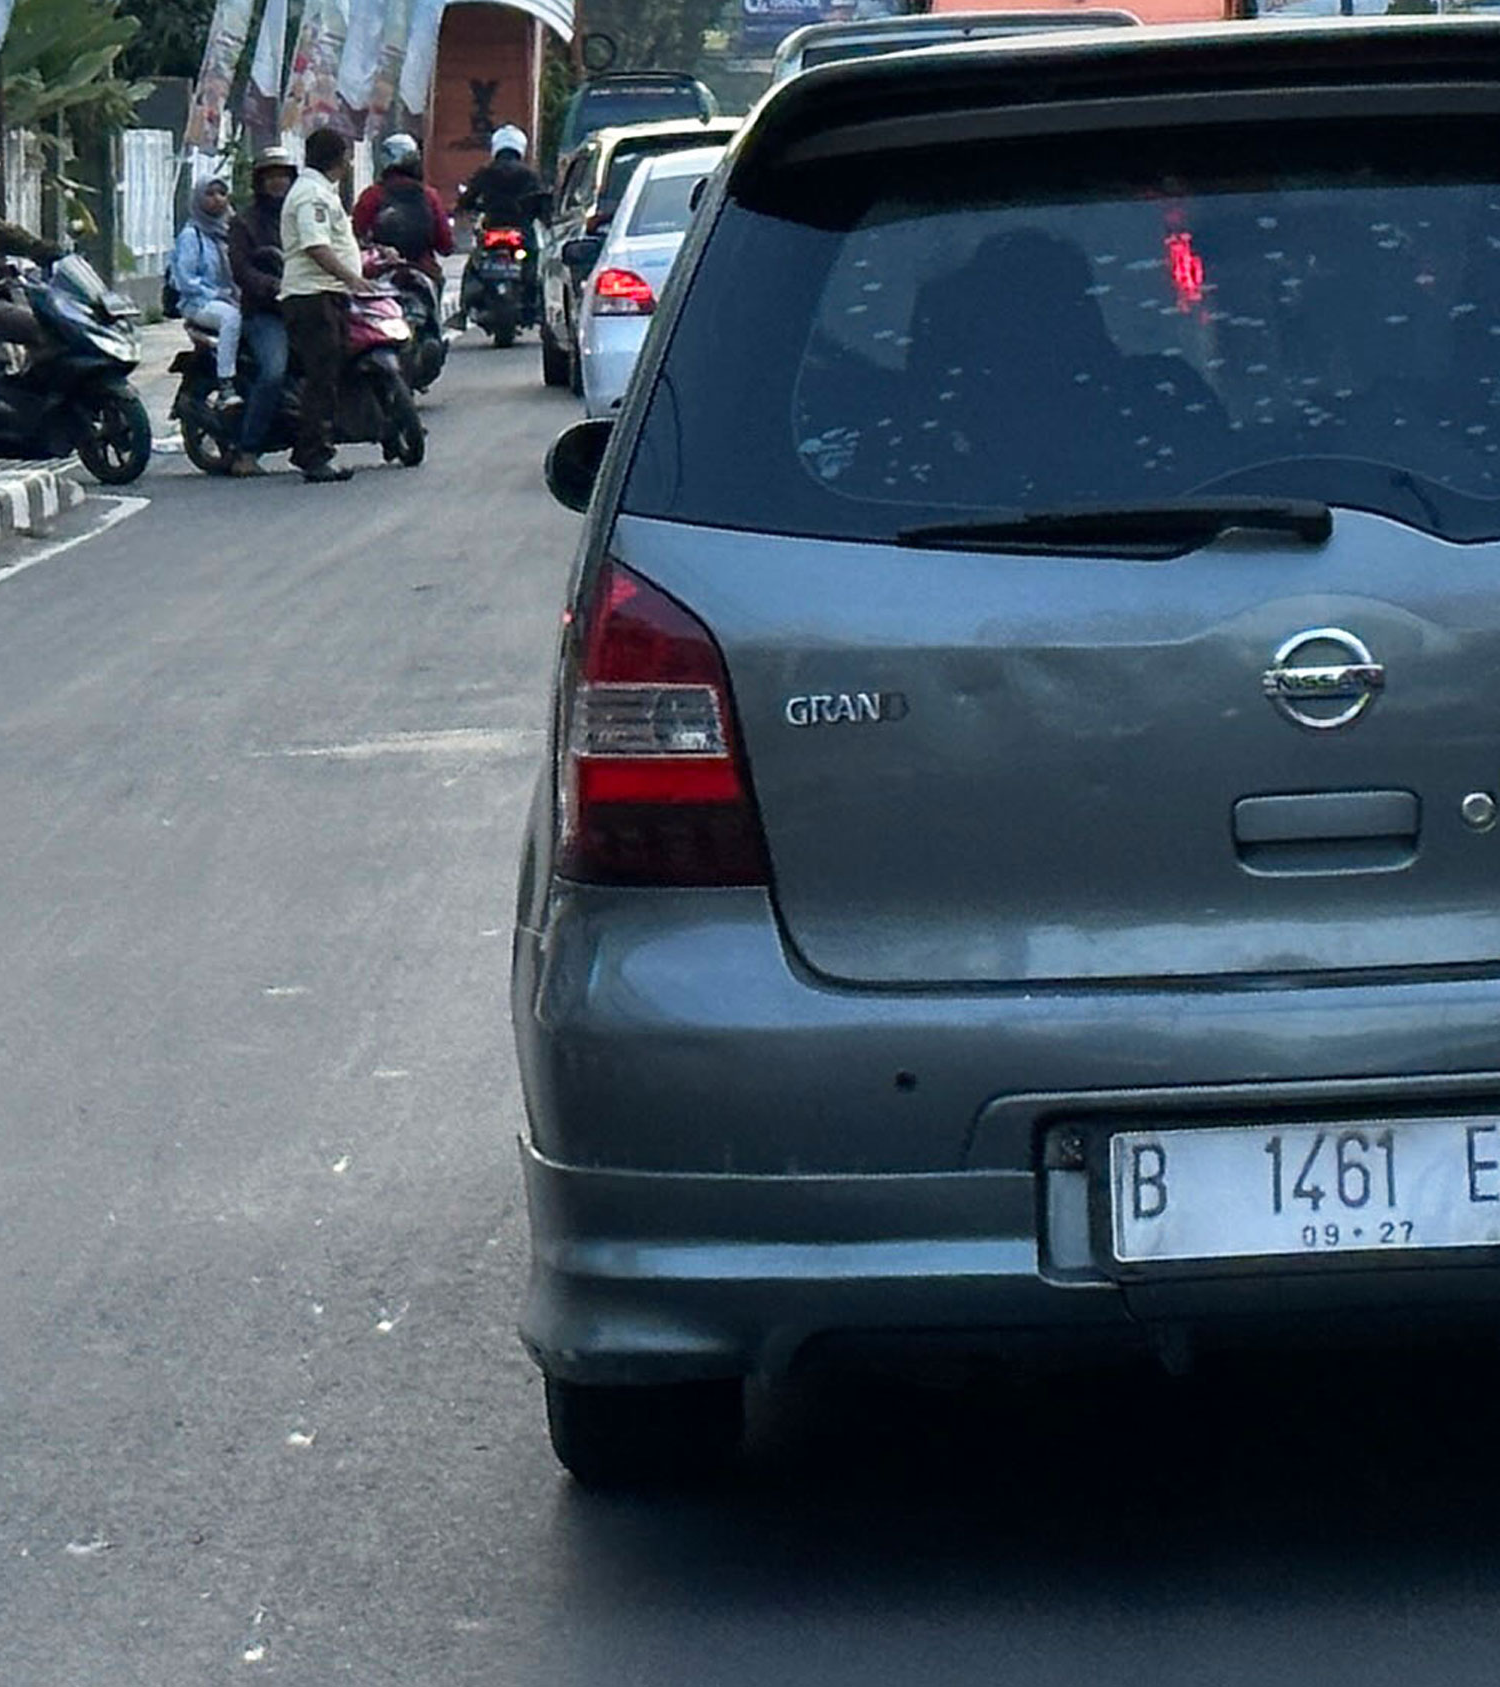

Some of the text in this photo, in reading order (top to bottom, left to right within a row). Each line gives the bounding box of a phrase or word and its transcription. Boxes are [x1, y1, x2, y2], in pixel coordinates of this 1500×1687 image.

[1132, 1143, 1167, 1219] B
[1264, 1128, 1397, 1215] 1461
[1302, 1220, 1414, 1247] 09 27
